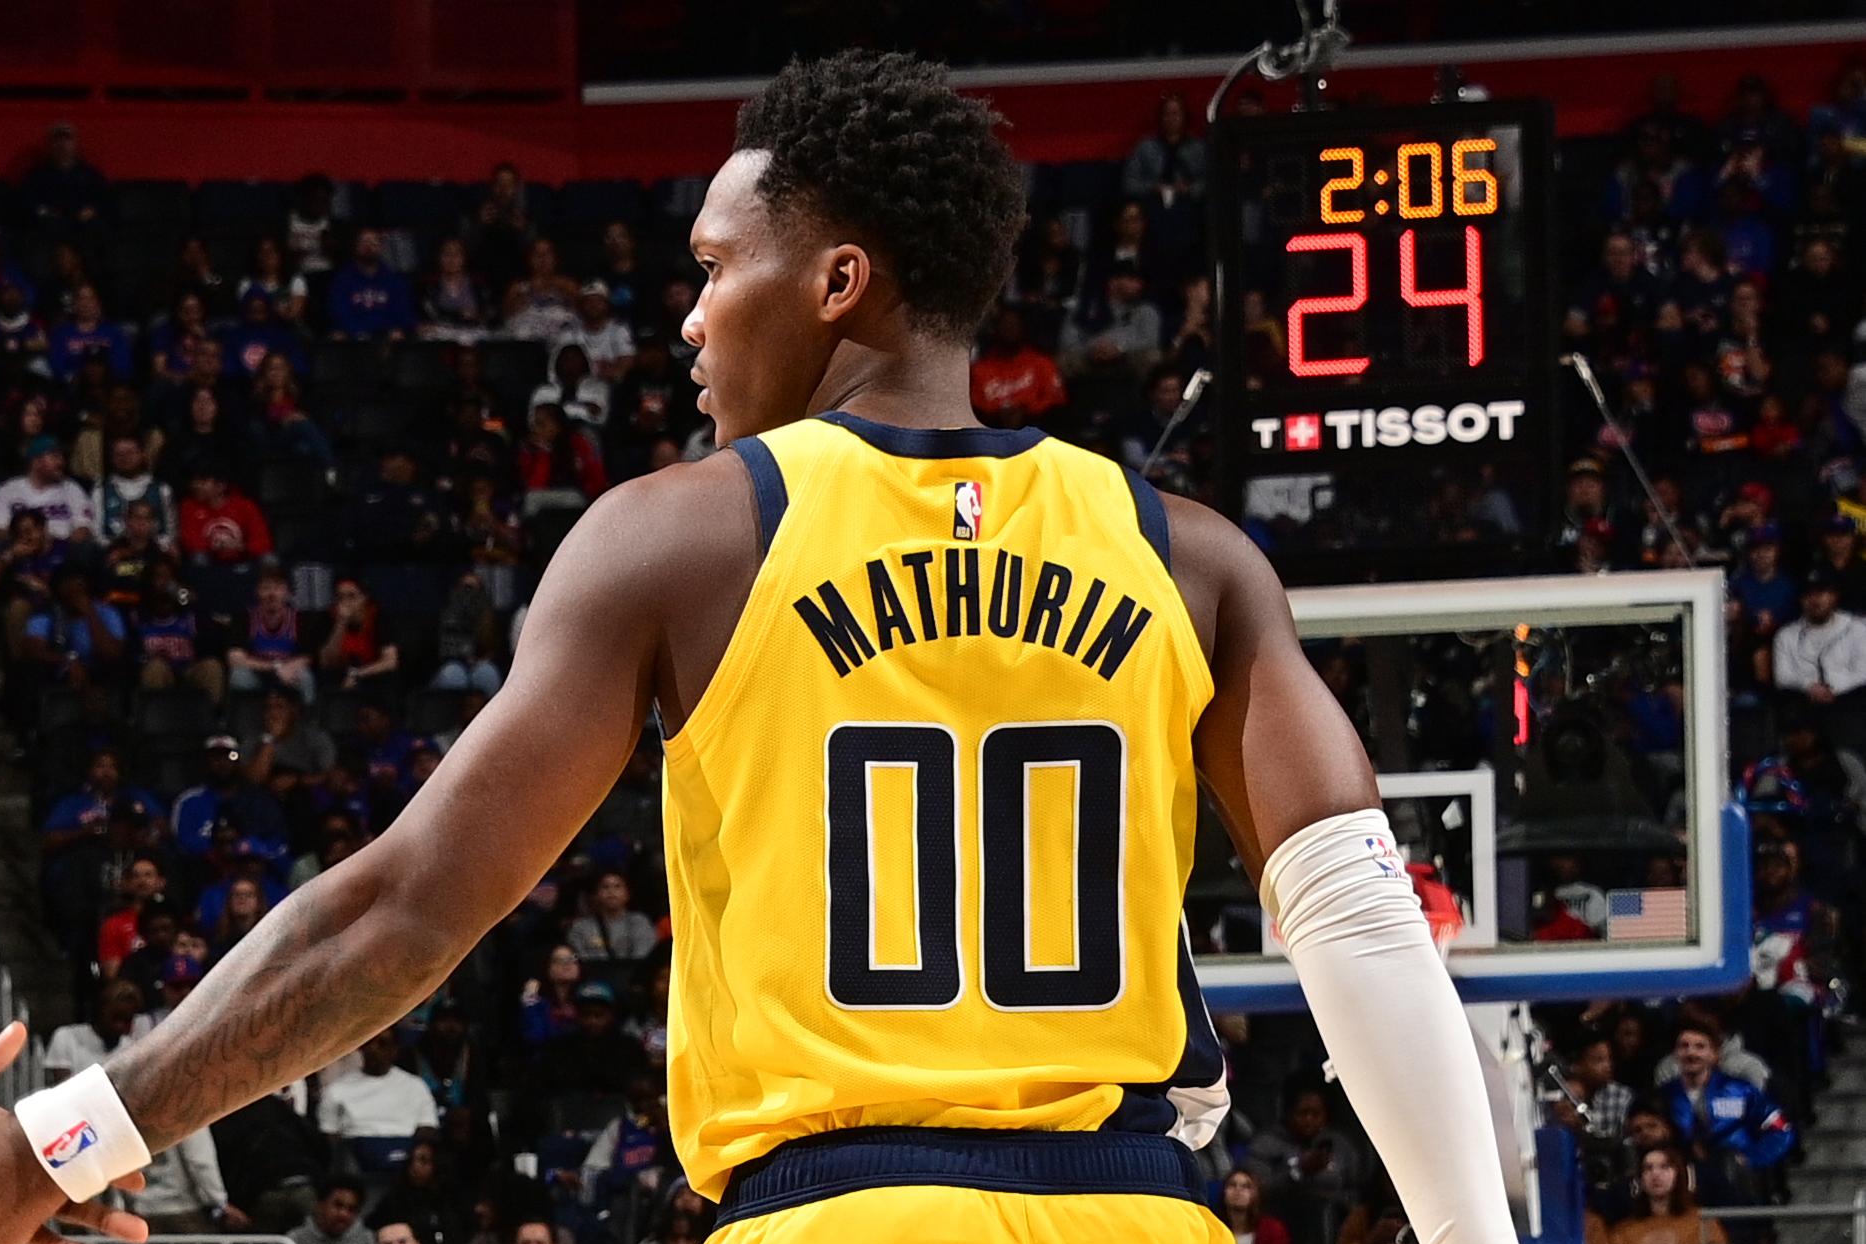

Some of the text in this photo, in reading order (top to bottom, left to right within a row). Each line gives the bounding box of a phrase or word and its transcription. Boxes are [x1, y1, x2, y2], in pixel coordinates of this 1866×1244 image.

[1319, 138, 1498, 224] 2:06
[1286, 225, 1484, 377] 24
[1324, 400, 1525, 449] TISSOT
[793, 548, 1153, 681] MATHURIN
[823, 720, 1127, 1012] 00
